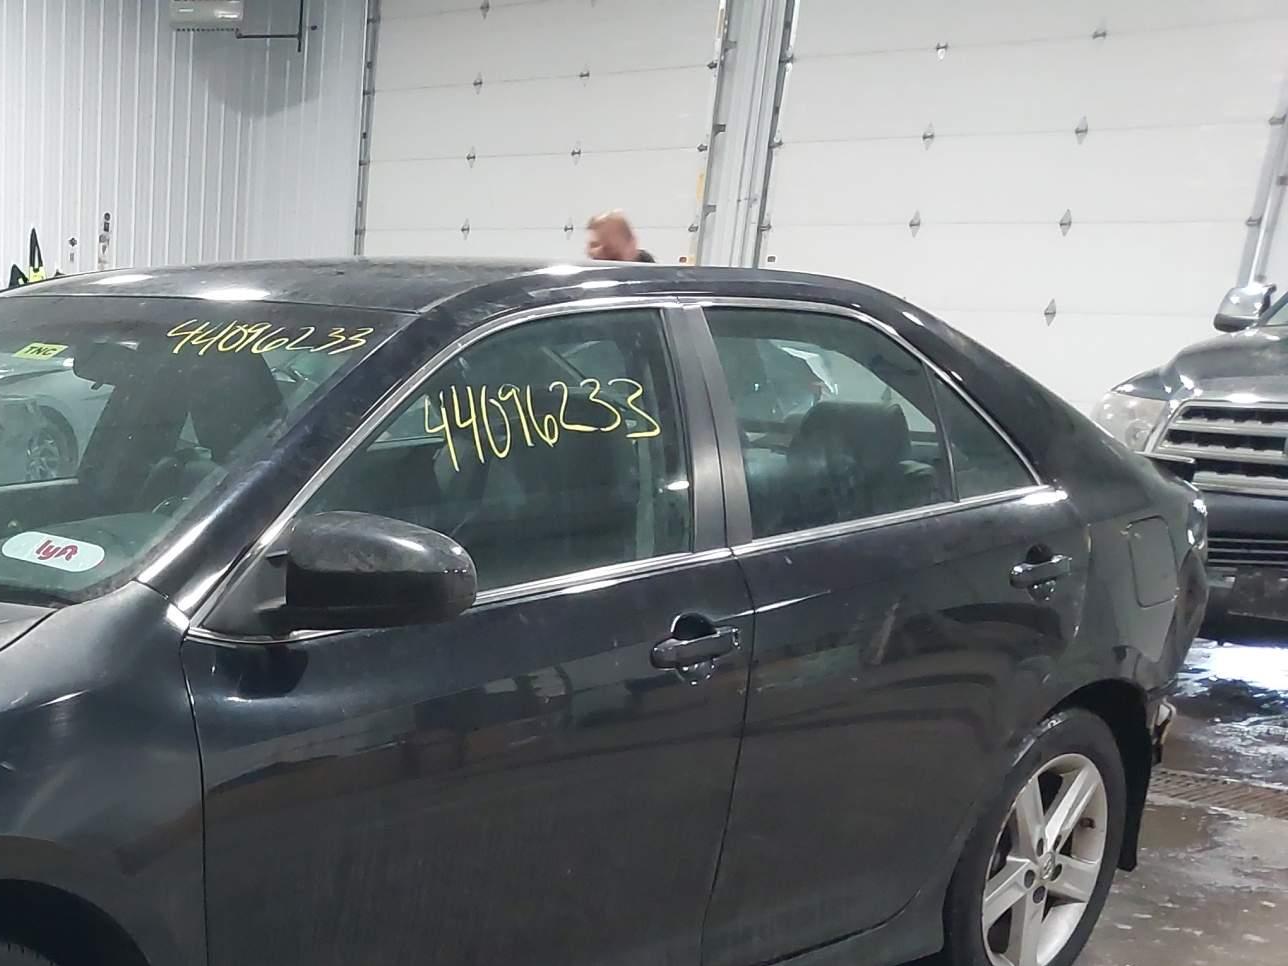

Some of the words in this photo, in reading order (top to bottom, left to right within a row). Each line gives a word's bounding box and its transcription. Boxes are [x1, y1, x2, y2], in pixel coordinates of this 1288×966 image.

[24, 346, 58, 356] TNC
[166, 318, 375, 356] 44096233
[424, 378, 661, 472] 44096233
